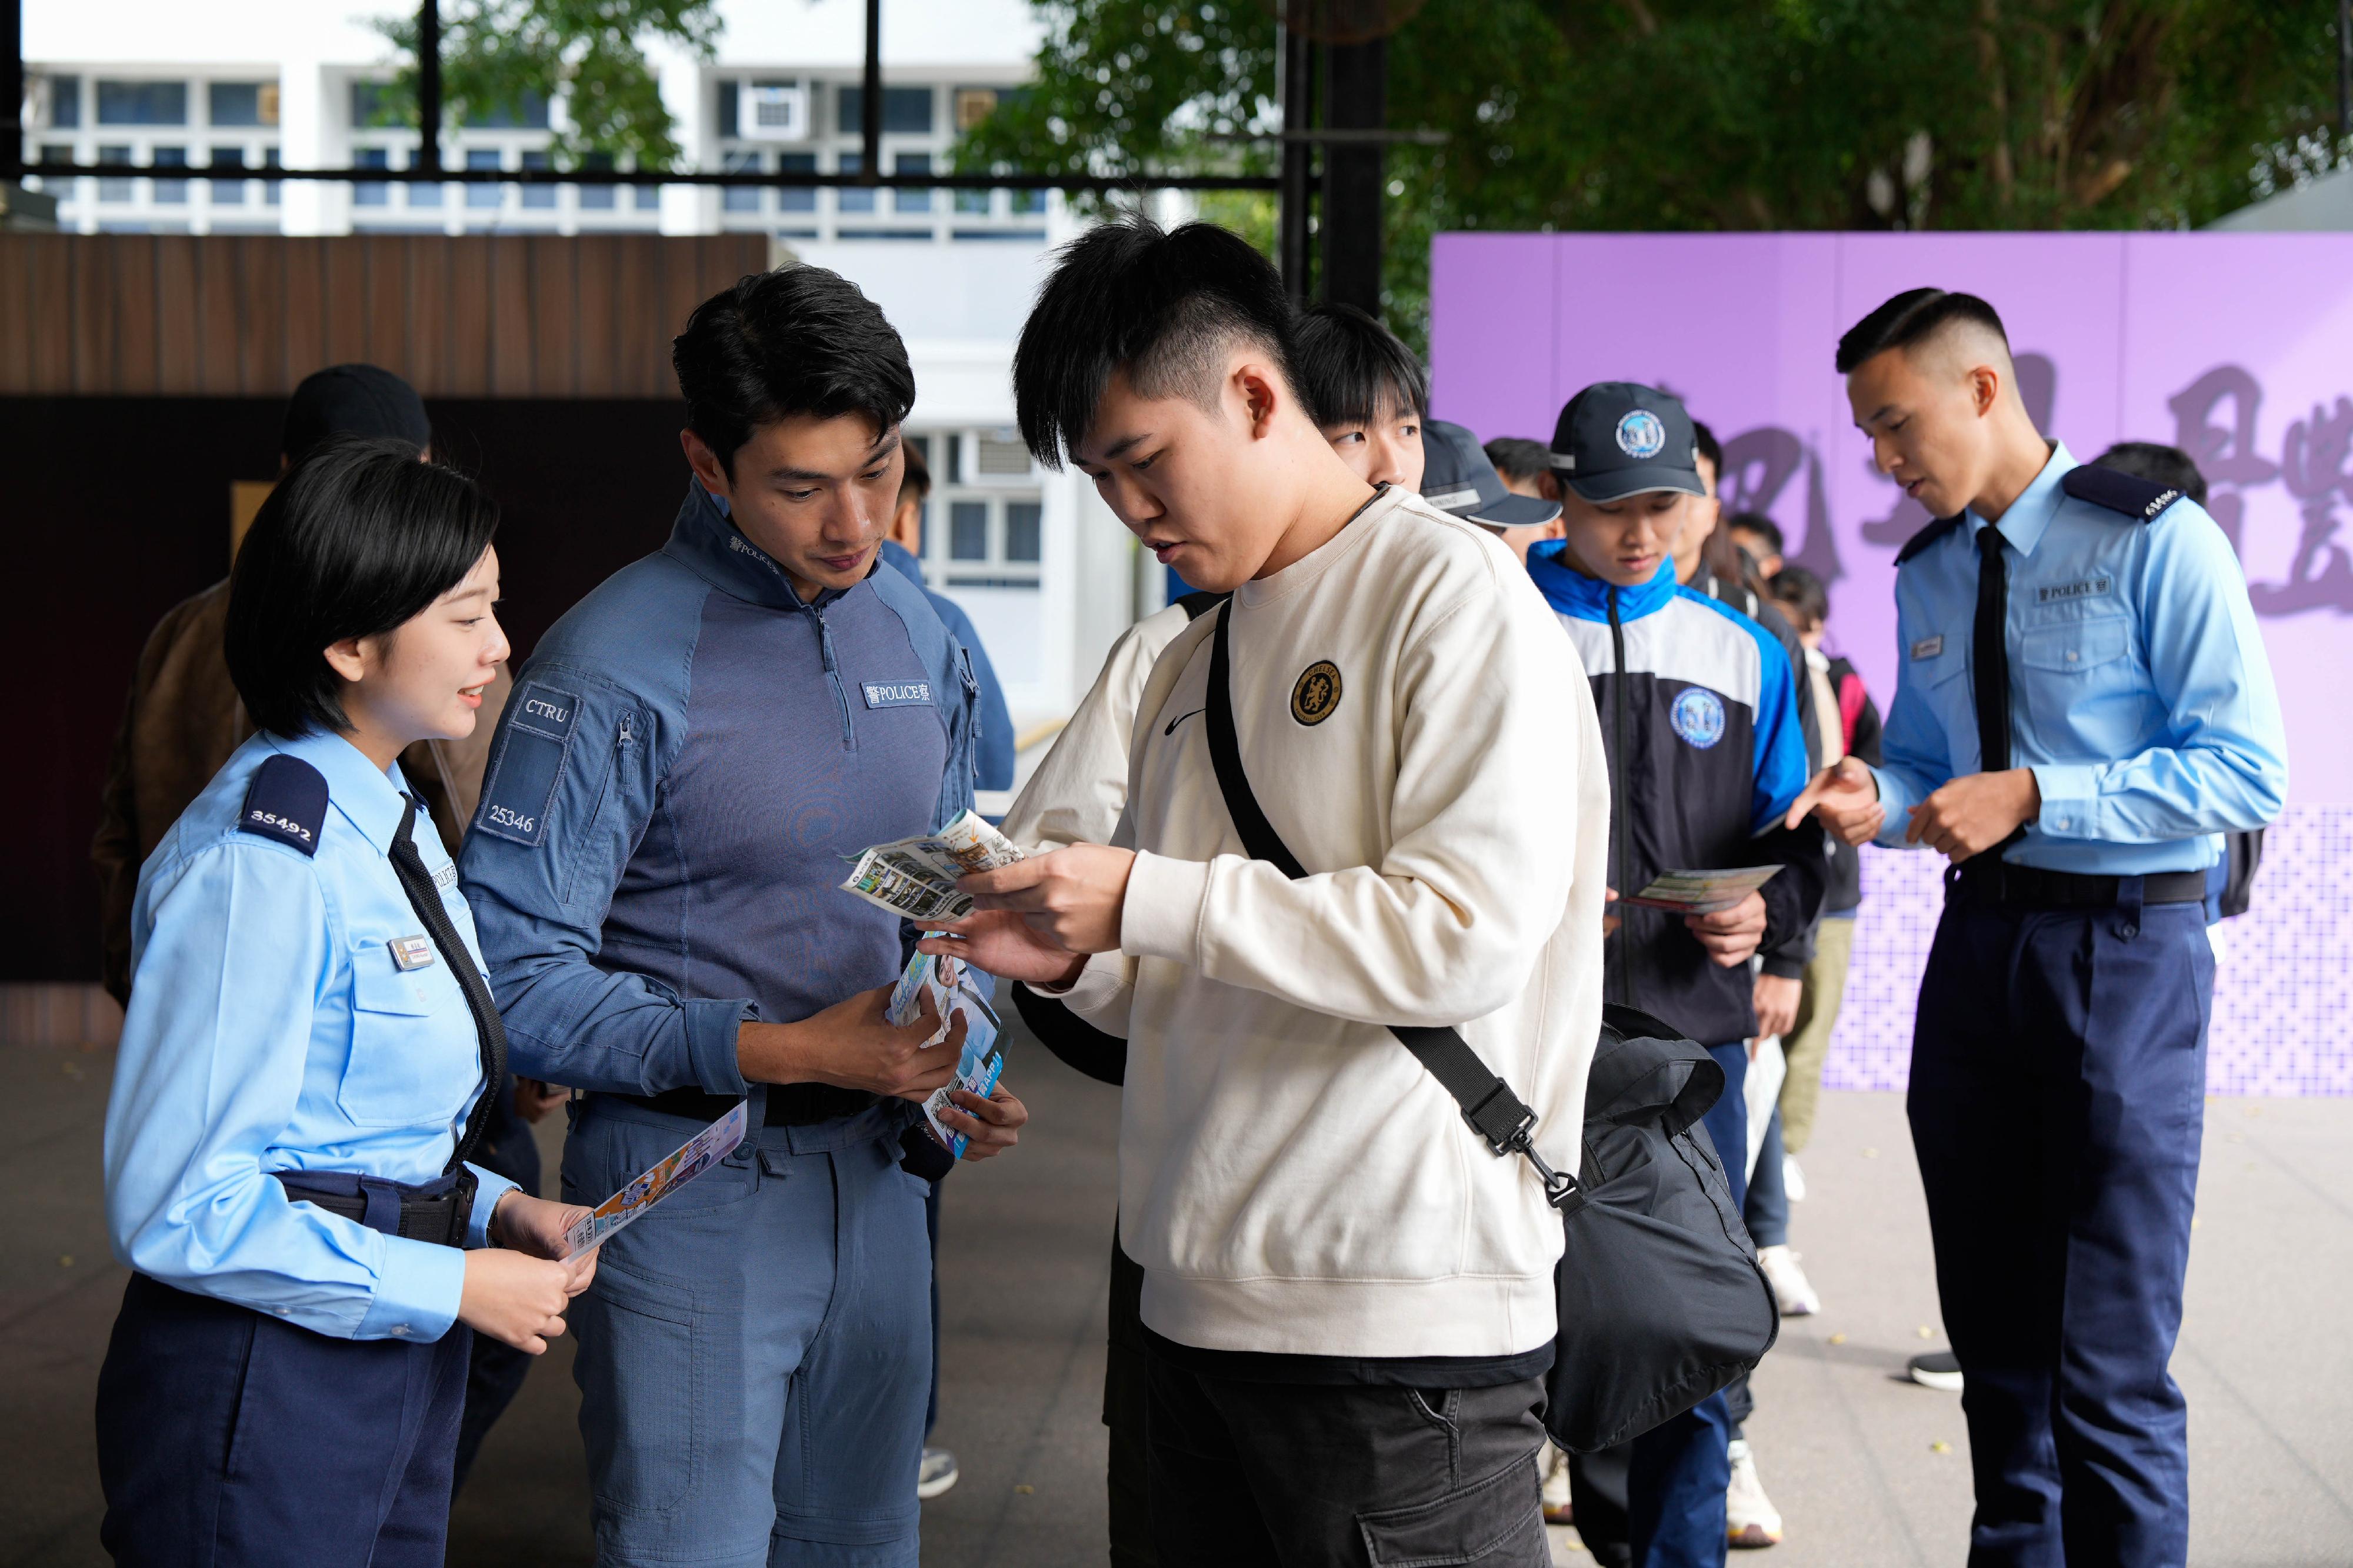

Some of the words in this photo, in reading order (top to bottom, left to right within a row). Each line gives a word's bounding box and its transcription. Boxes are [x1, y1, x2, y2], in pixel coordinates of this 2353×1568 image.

[741, 546, 774, 569] POLICE
[2051, 581, 2091, 598] POLICE
[879, 685, 921, 700] POLICE
[525, 699, 568, 723] CTRU
[251, 810, 311, 842] 35492
[488, 805, 535, 833] 25346
